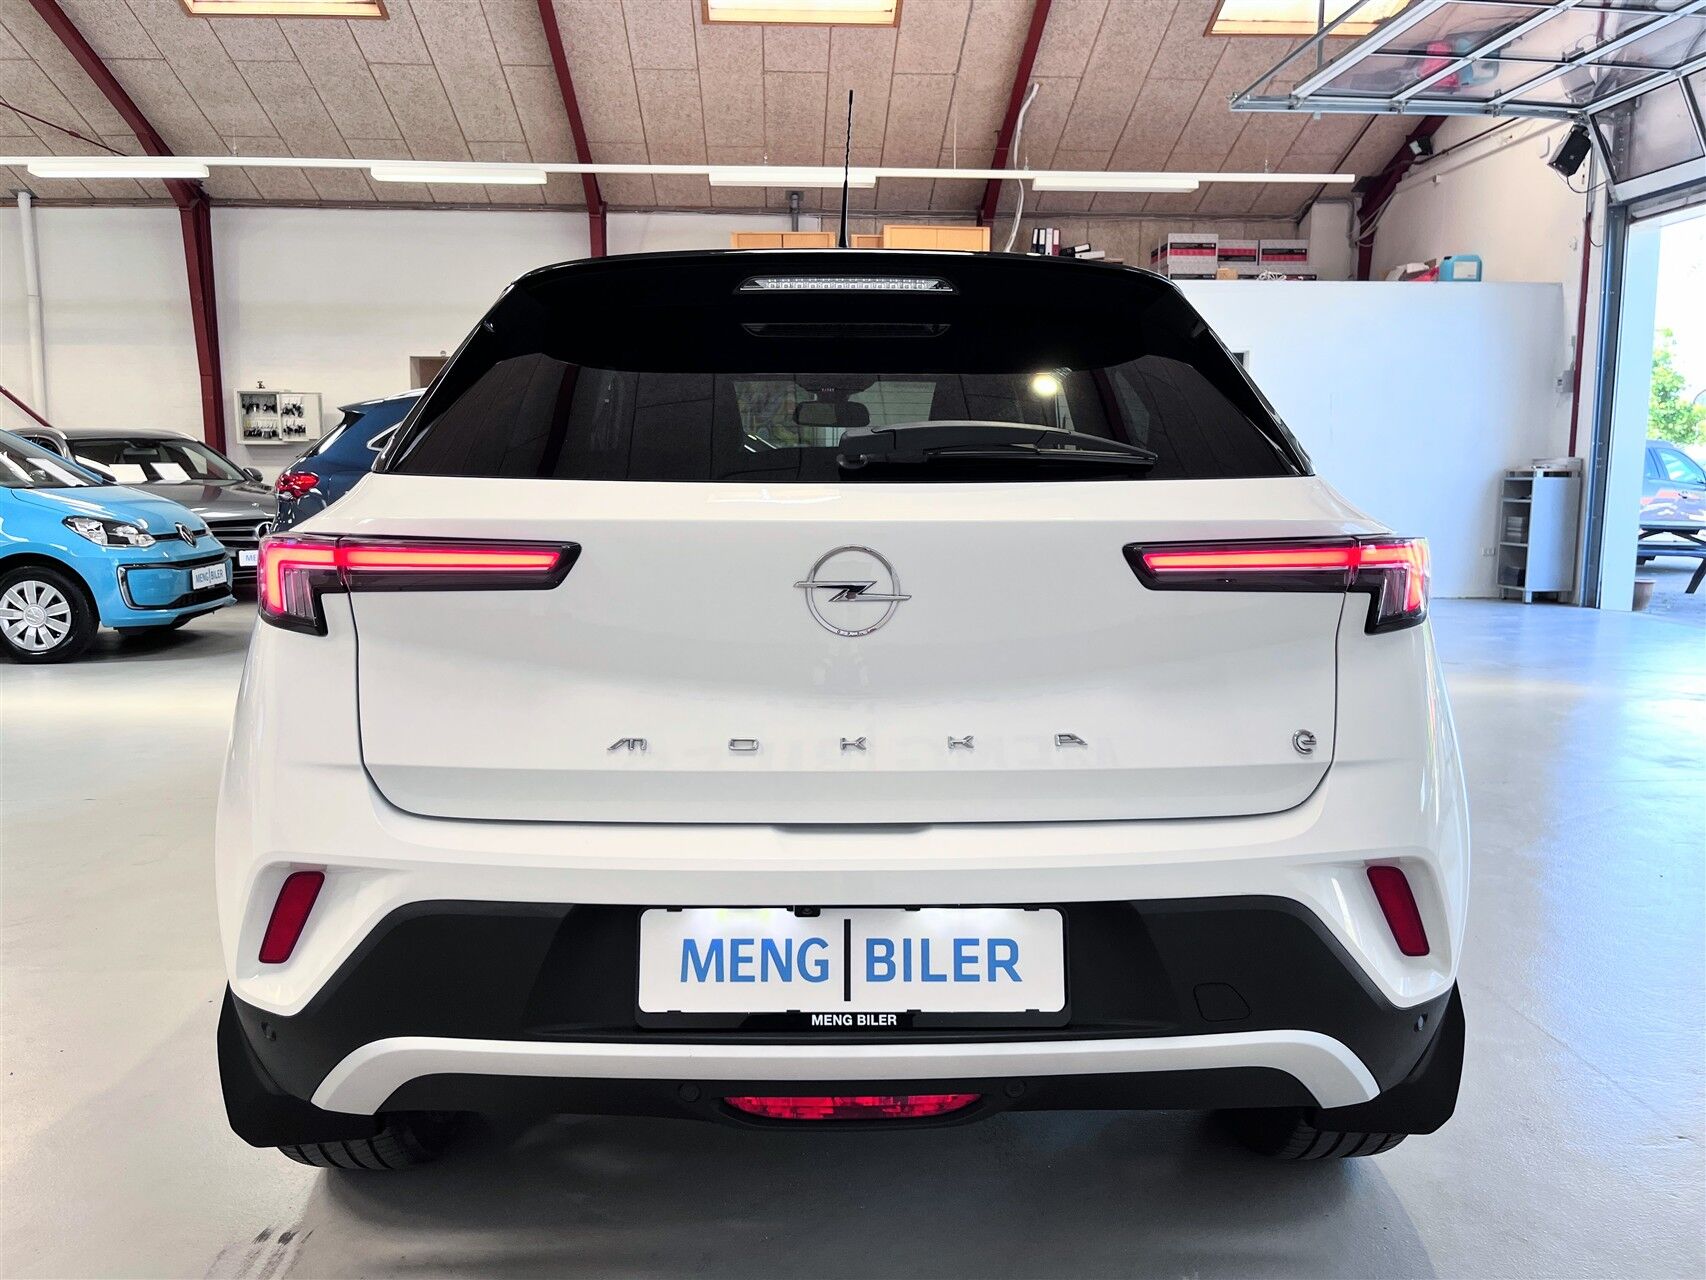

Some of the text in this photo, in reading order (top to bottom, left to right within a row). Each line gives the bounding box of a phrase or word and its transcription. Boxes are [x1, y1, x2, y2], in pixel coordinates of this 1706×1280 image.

[607, 733, 1088, 751] MOKKA
[680, 937, 1023, 983] MENG BILER
[811, 1014, 897, 1026] MENG BILER
